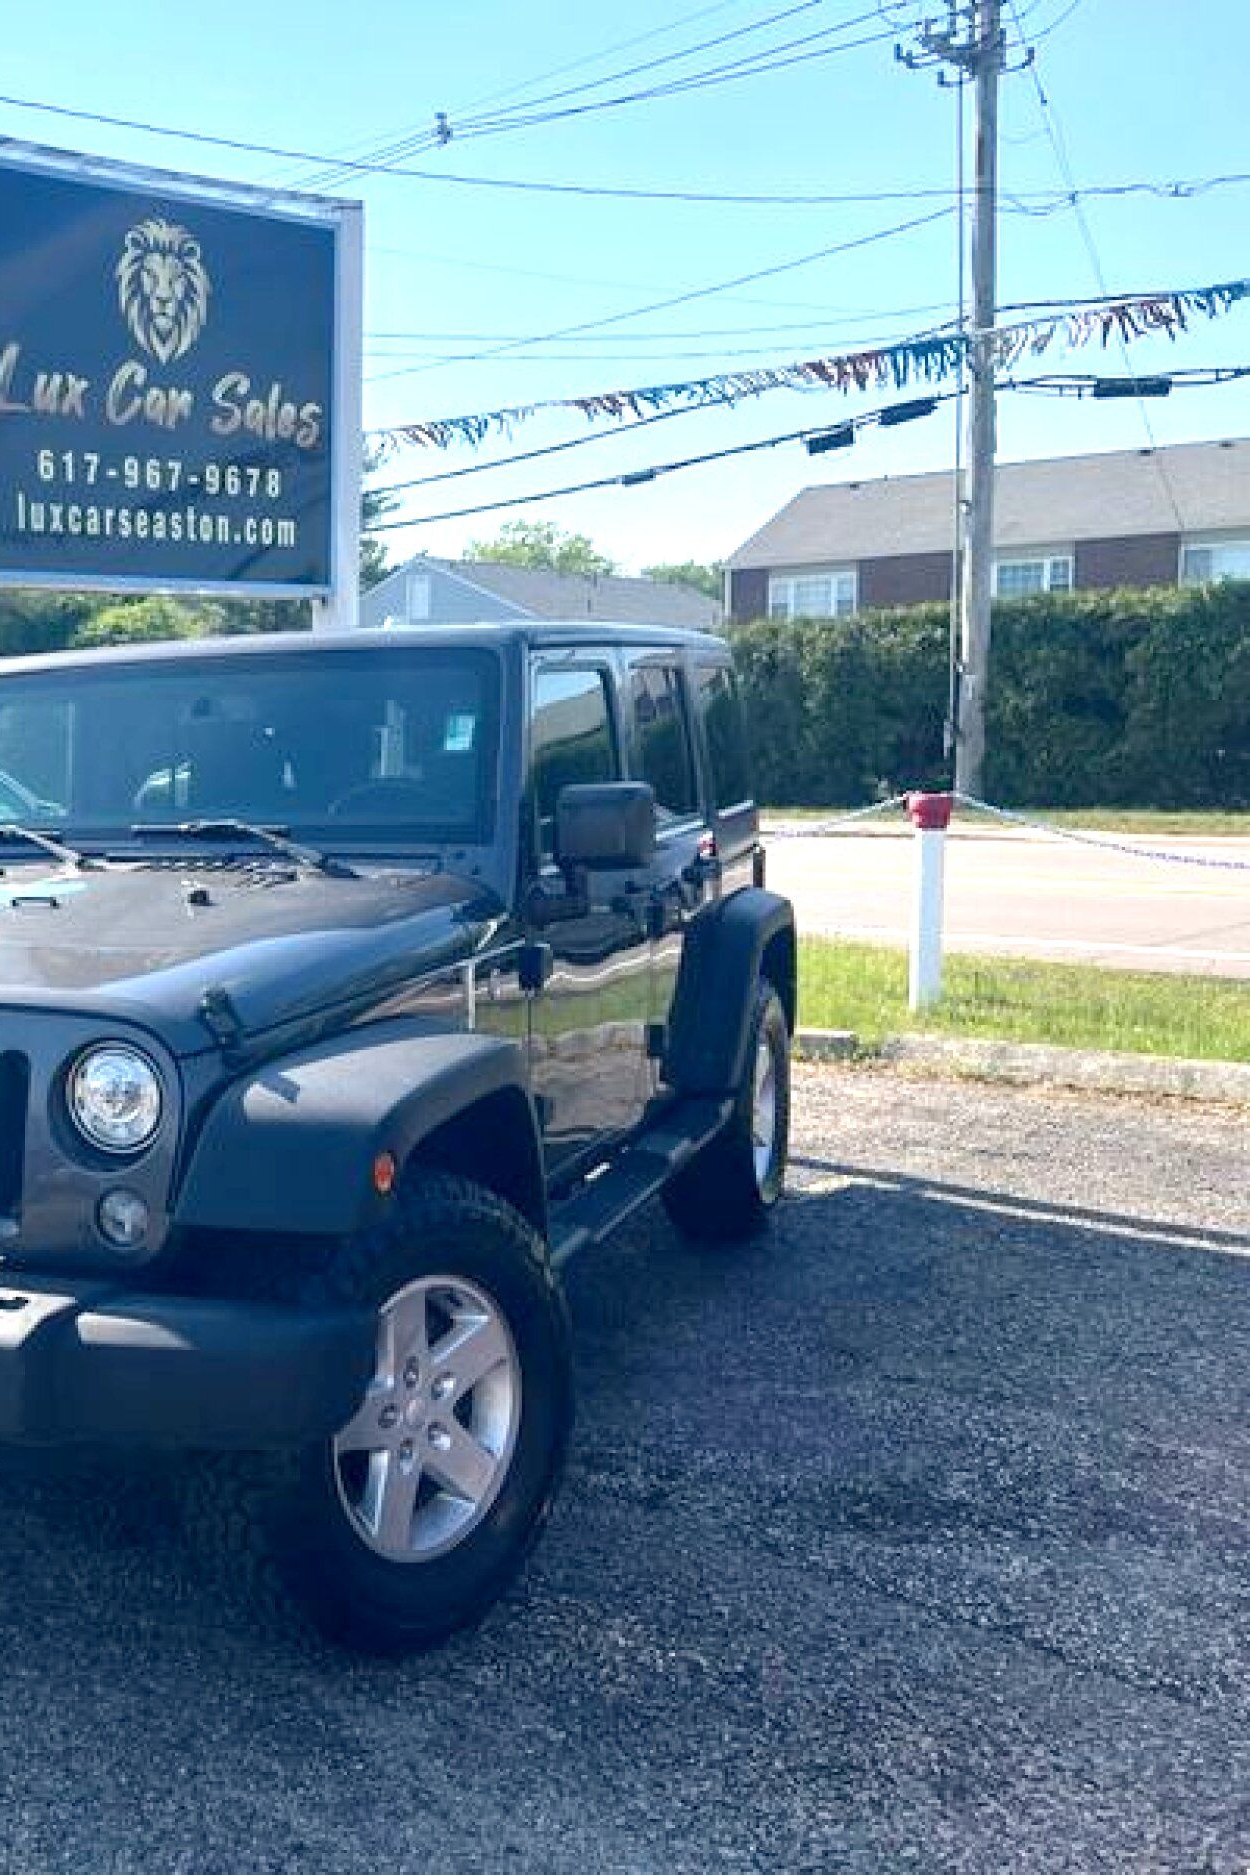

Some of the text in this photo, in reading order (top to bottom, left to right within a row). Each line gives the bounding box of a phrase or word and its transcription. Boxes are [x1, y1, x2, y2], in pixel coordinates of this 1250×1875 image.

[105, 360, 194, 429] Car
[210, 370, 324, 449] Sales
[36, 448, 282, 498] 617-967-9678
[17, 491, 298, 547] luxcarseaston.com
